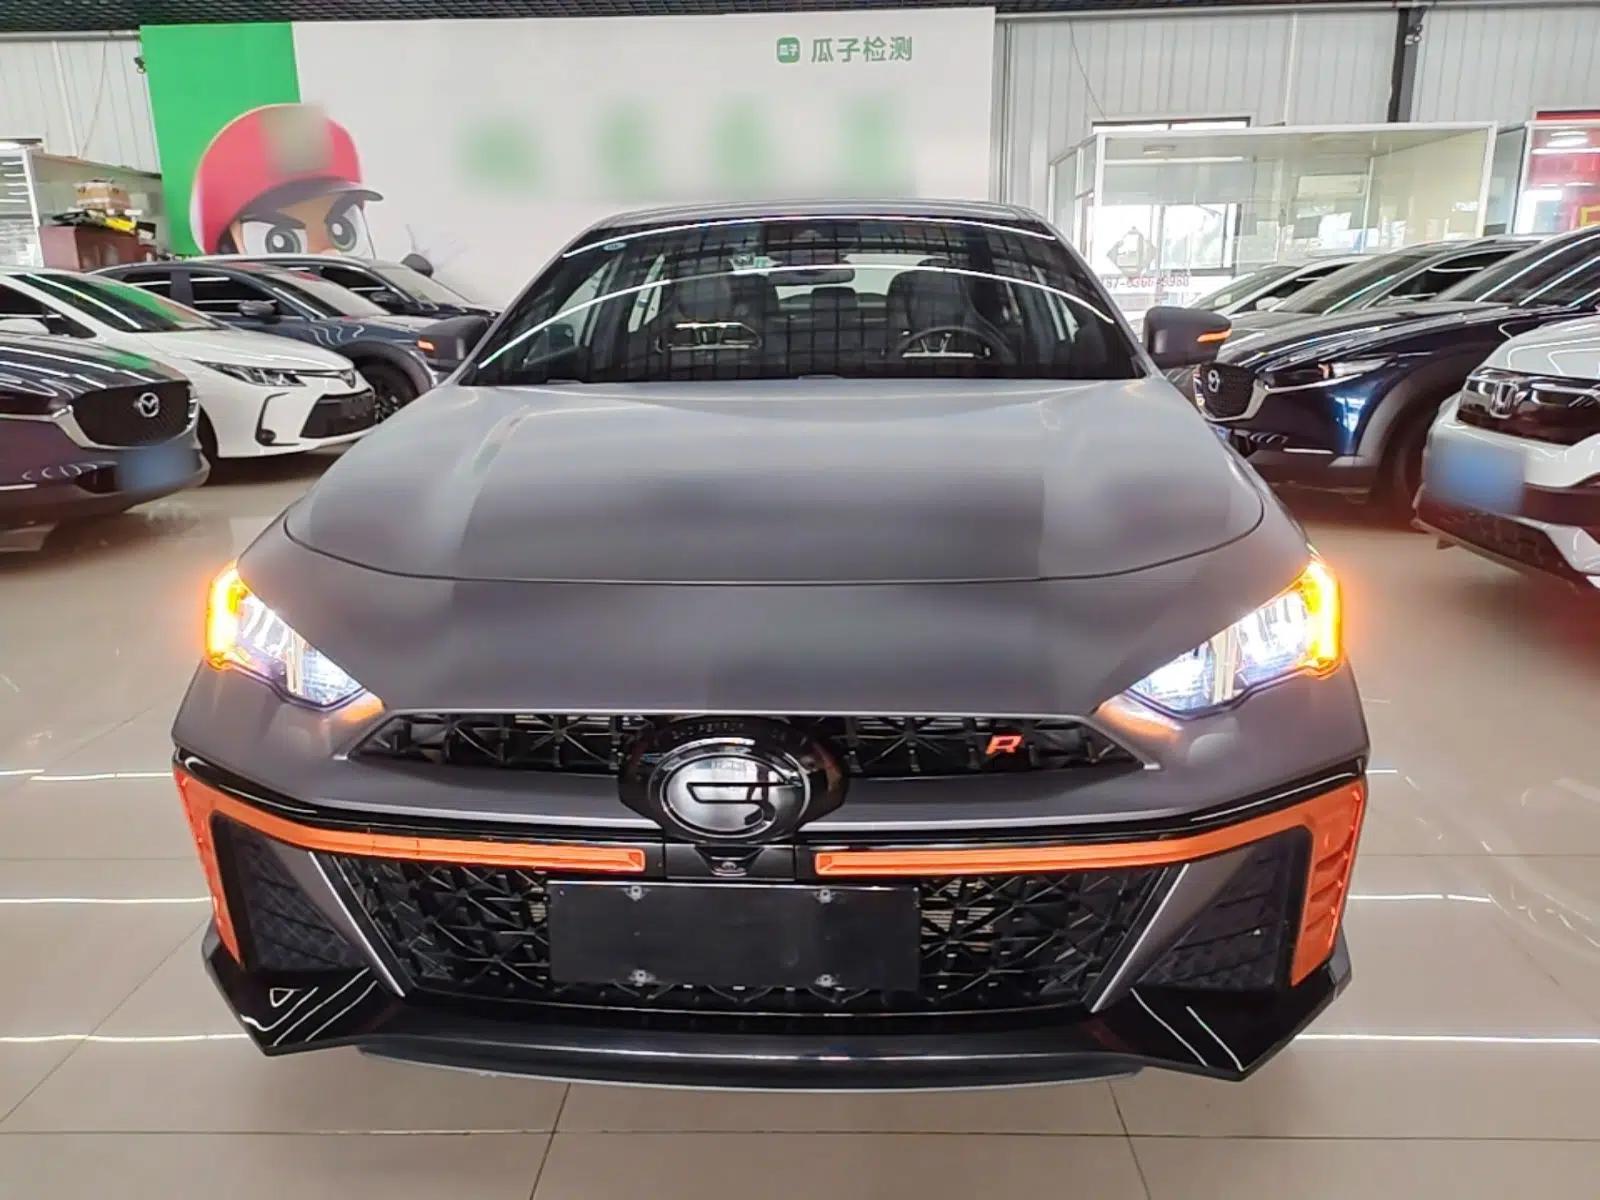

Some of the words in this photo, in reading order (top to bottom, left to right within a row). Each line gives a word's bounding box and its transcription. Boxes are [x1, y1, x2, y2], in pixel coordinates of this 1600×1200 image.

[810, 36, 913, 63] 瓜子检测
[985, 735, 1022, 755] R
